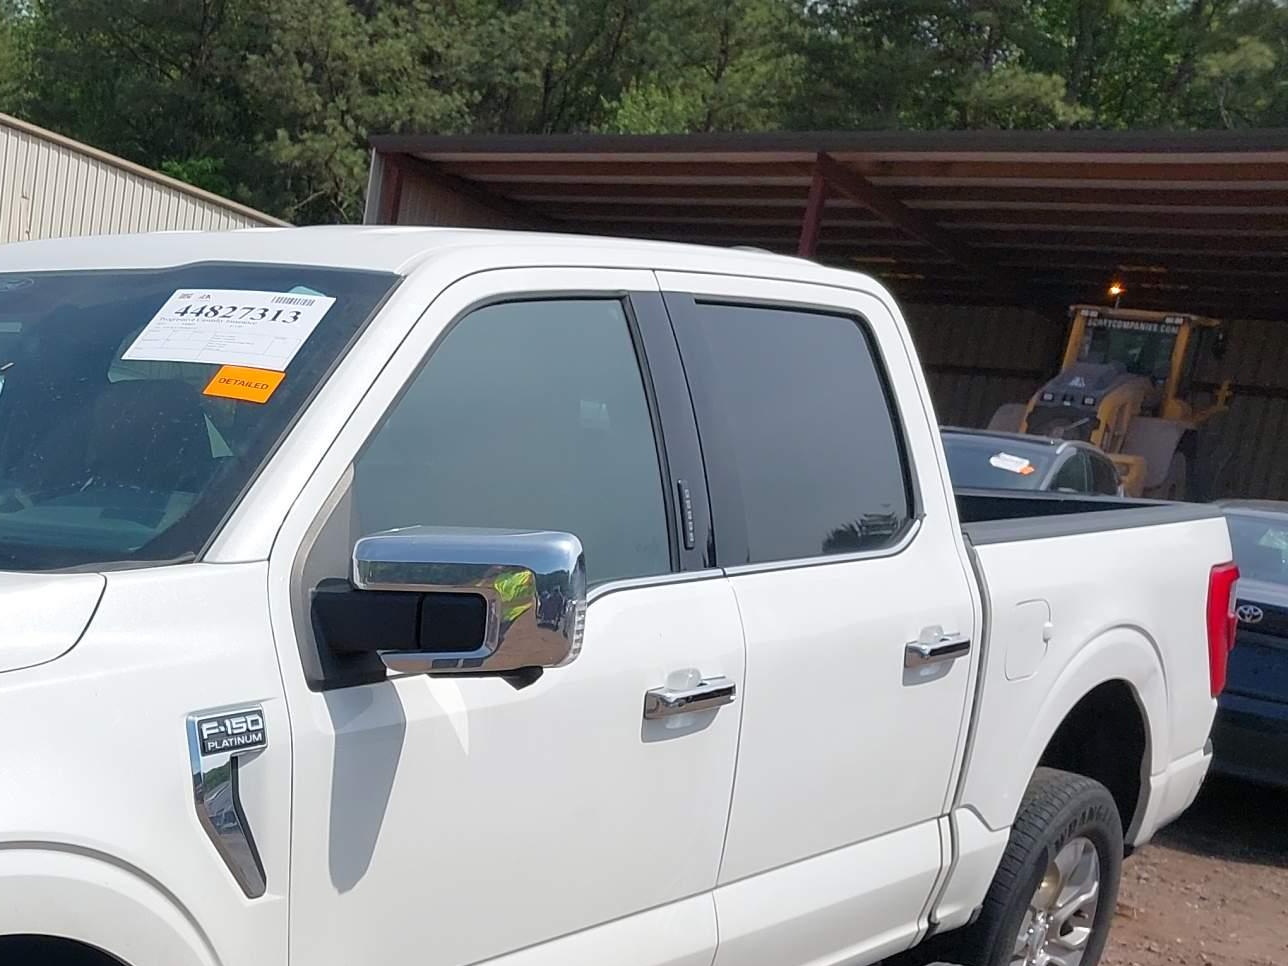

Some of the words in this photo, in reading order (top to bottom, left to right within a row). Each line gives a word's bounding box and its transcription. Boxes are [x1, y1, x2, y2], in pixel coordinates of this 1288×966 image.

[174, 304, 302, 324] 44827313
[218, 377, 269, 391] DETAILED
[201, 714, 264, 740] F-150
[207, 732, 263, 751] PLATINUM
